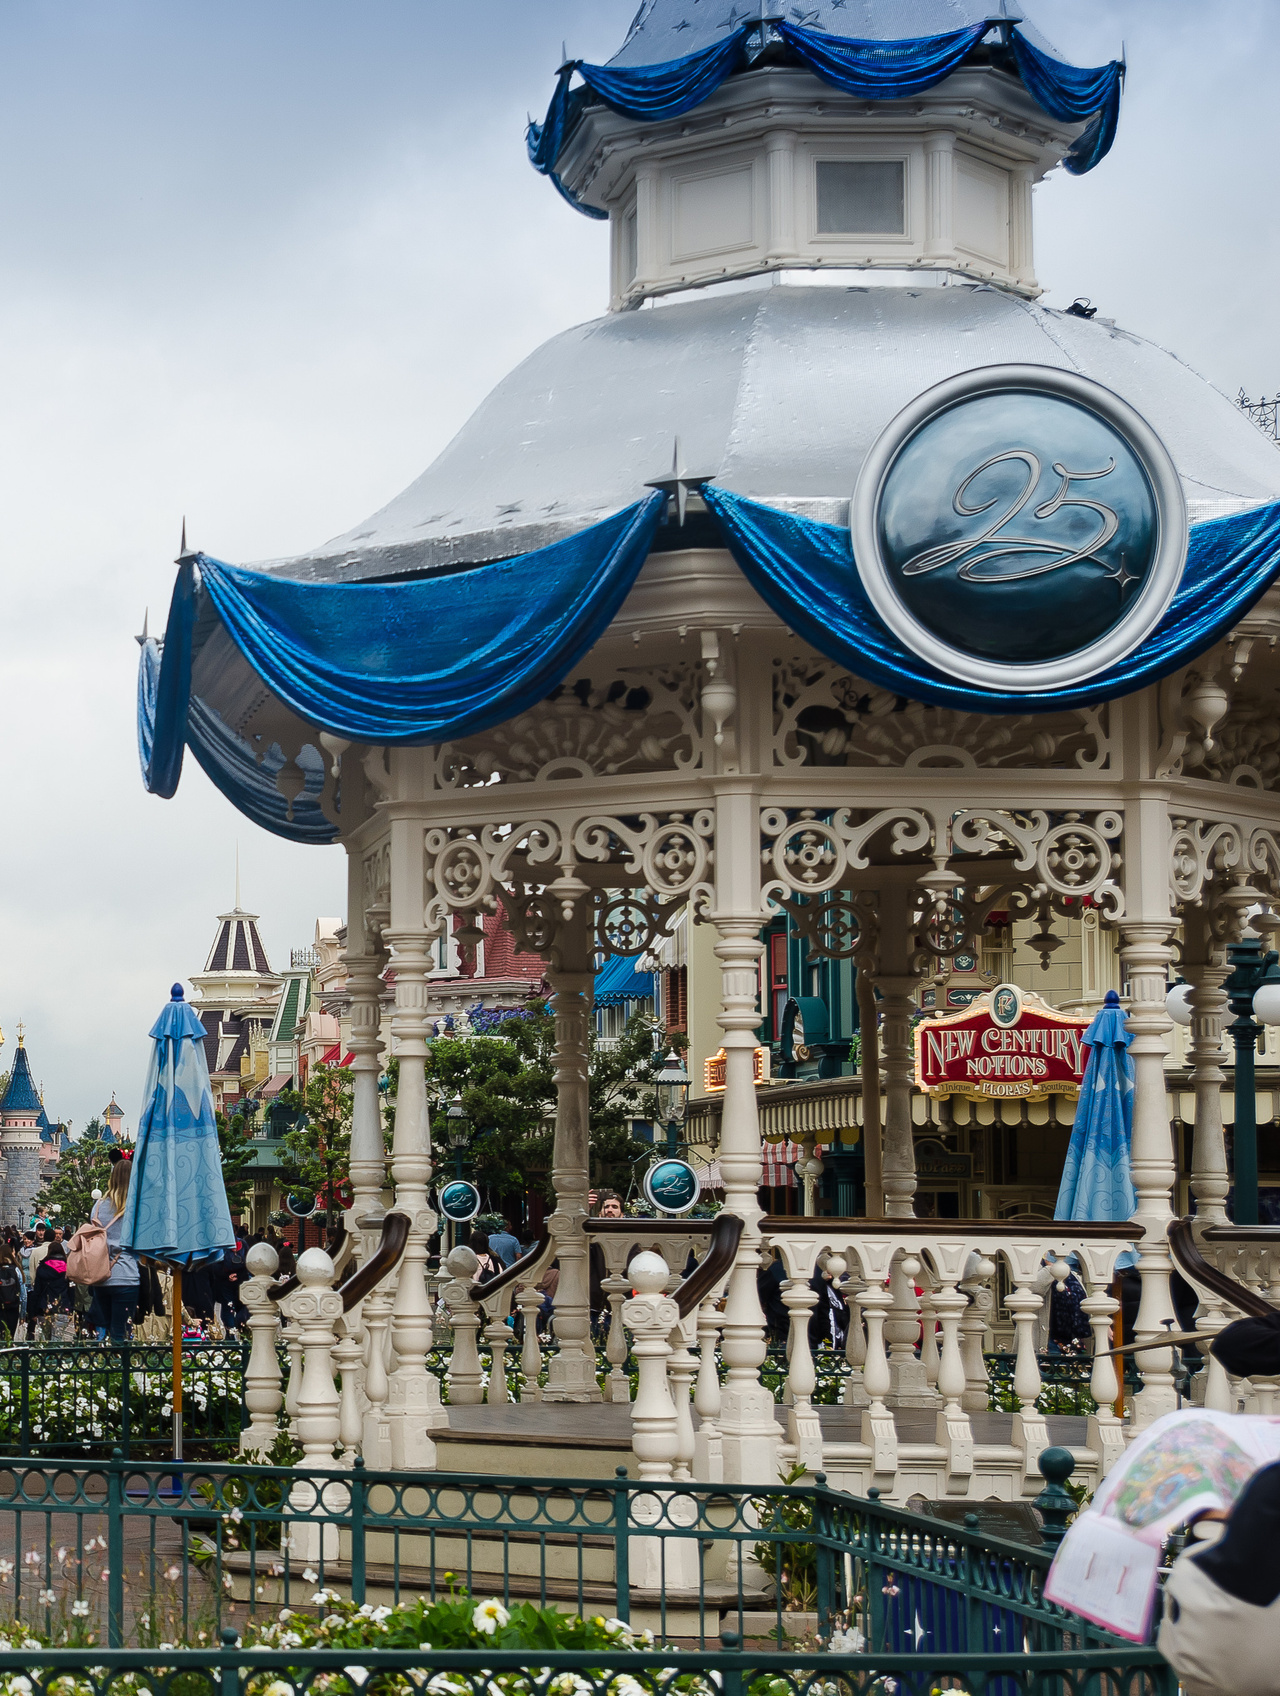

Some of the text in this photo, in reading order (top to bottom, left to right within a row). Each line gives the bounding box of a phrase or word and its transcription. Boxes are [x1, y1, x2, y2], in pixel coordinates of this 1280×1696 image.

[902, 450, 1118, 582] 25
[925, 1027, 1087, 1076] NEW CENTURY
[966, 1055, 1047, 1076] NOTIONS
[941, 1082, 1075, 1096] Unique FLORA'S Boutique
[653, 1174, 690, 1196] 25
